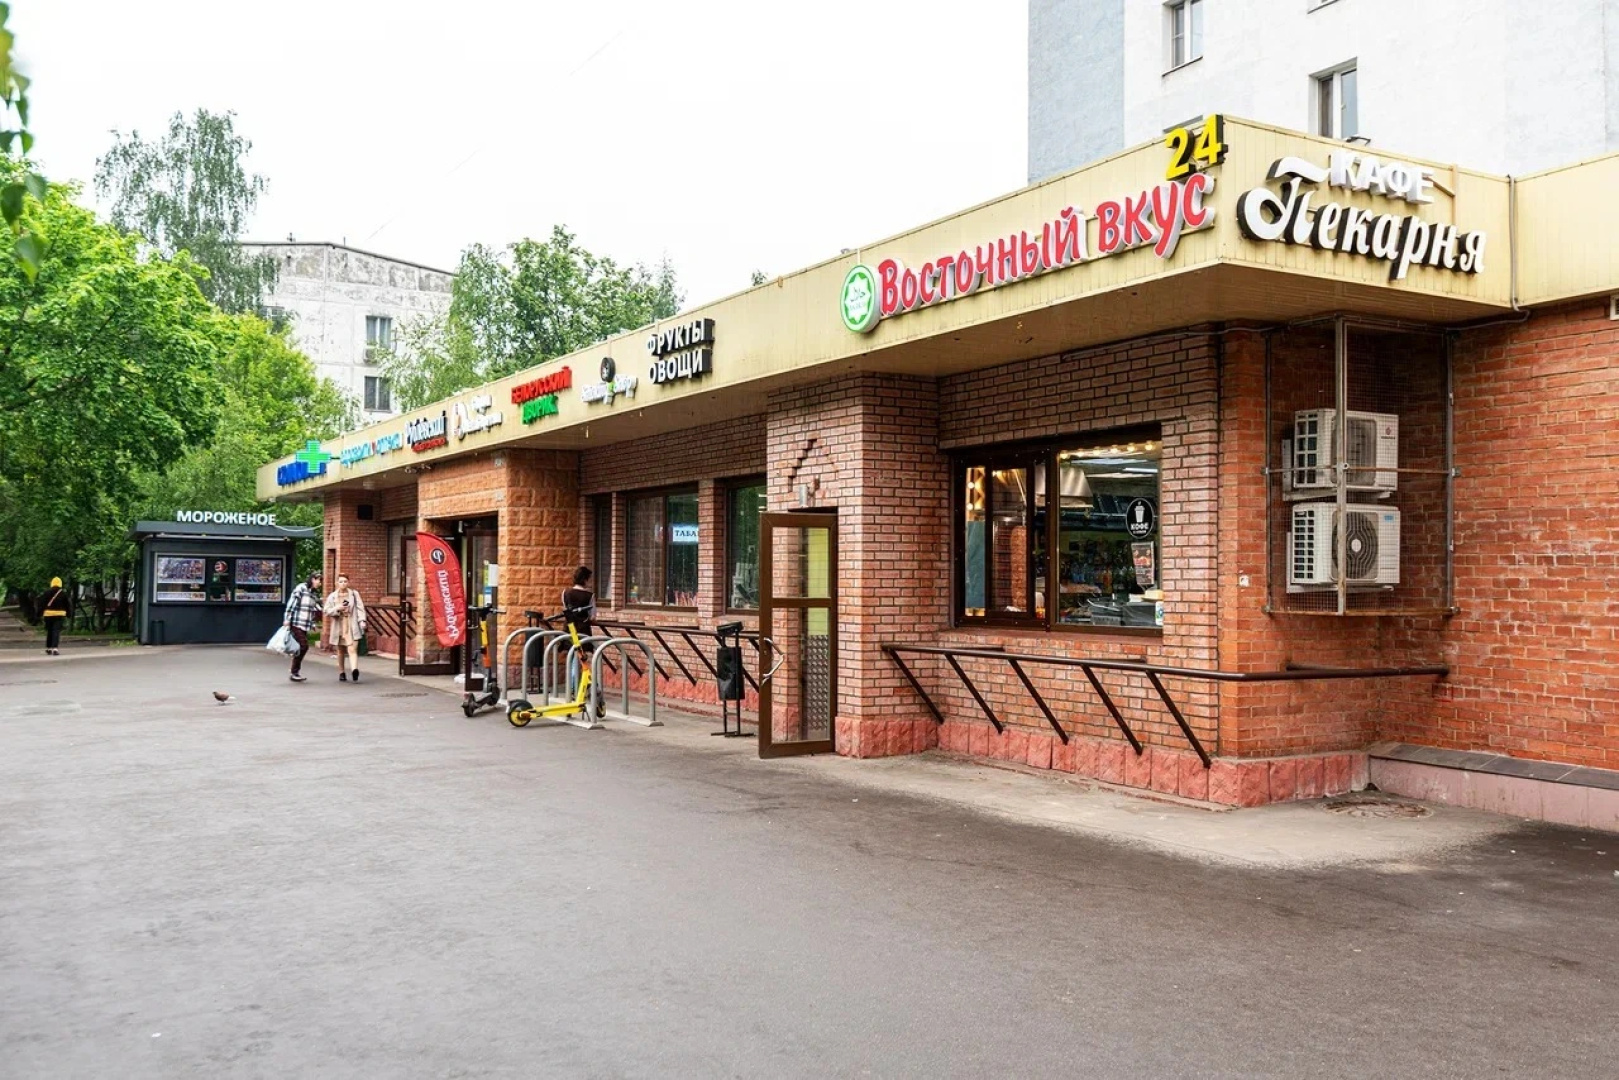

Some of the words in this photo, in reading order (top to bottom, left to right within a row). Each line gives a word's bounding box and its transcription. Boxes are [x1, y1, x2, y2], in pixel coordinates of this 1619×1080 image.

[1165, 114, 1224, 181] 24
[1330, 152, 1434, 205] КАФЕ
[1238, 157, 1487, 281] Пекарня
[646, 318, 709, 355] ФРУКТЫ
[649, 348, 708, 384] ОВОЩИ
[176, 510, 277, 526] МОРОЖЕНОЕ
